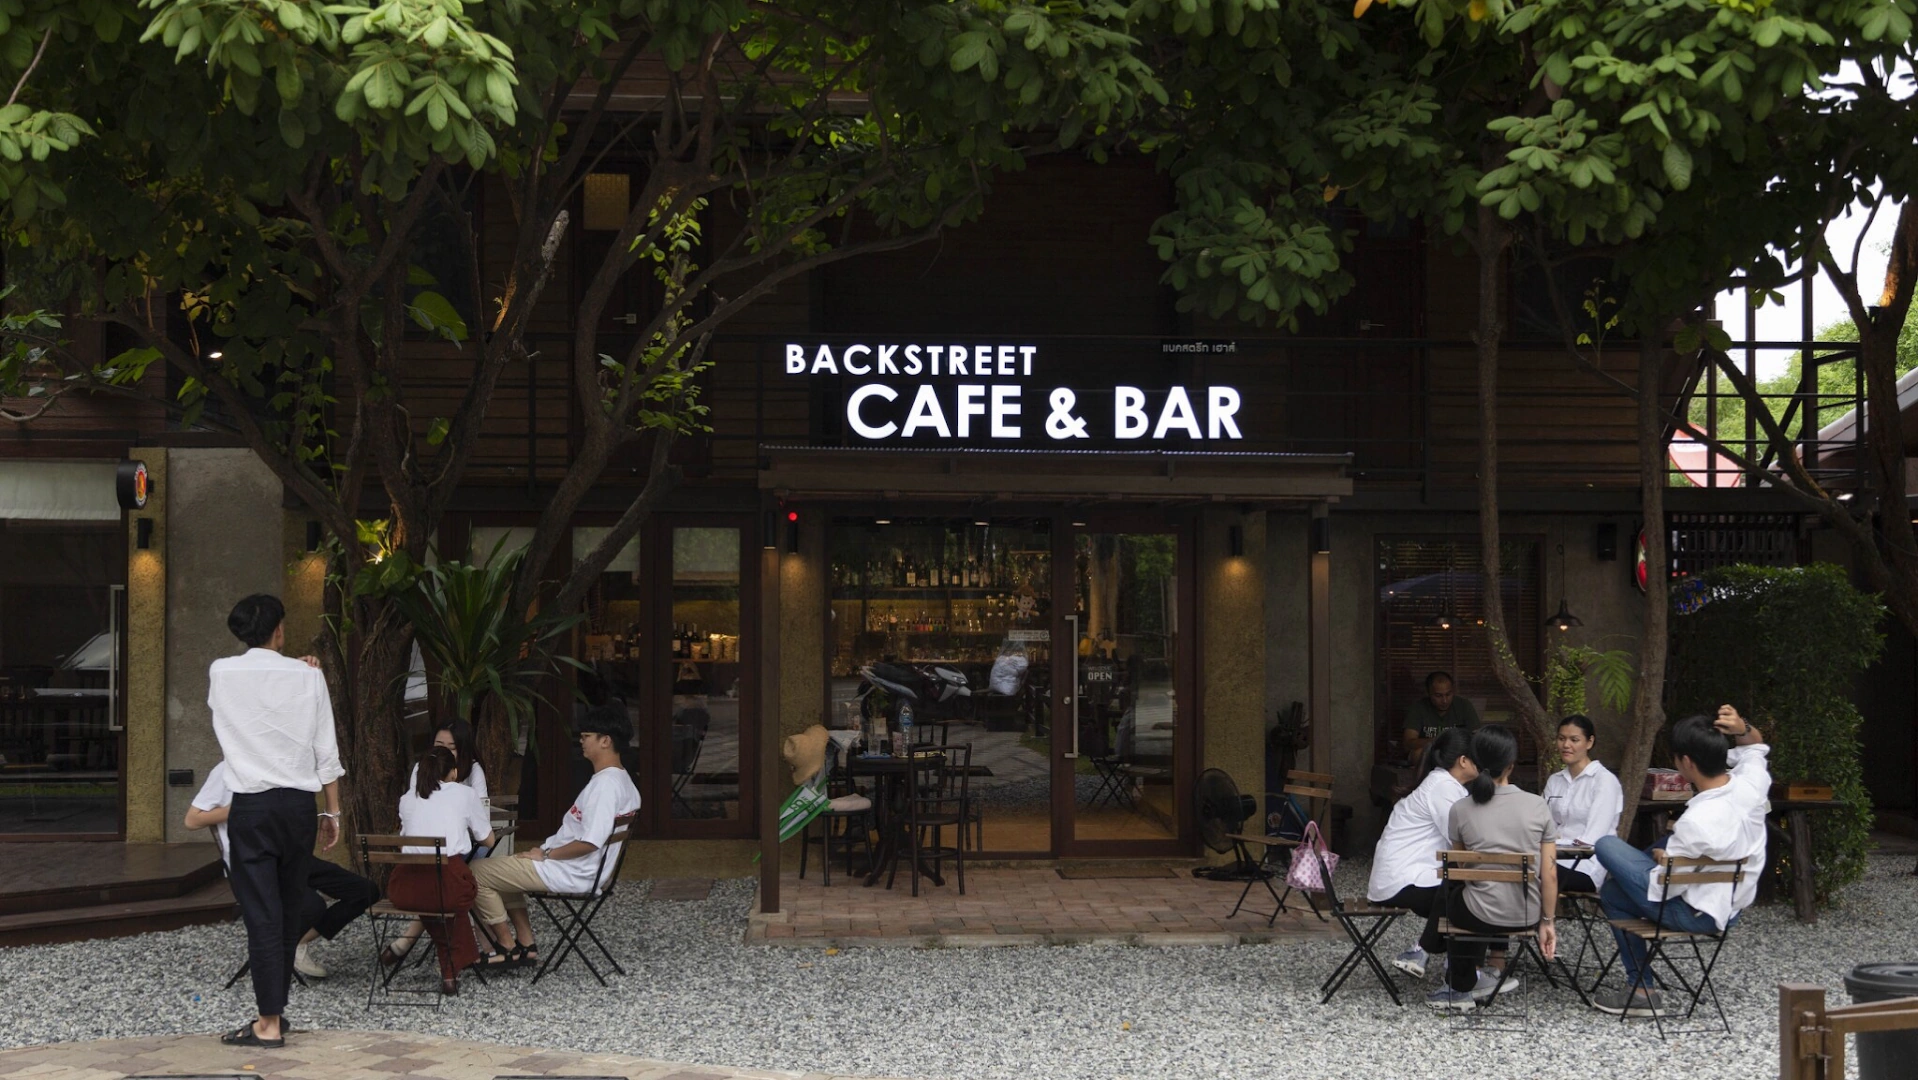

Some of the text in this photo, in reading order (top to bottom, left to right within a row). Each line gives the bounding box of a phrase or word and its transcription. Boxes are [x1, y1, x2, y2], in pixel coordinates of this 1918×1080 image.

[786, 343, 1037, 376] BACKSTREET
[846, 383, 1243, 440] CAFE & BAR
[1088, 672, 1112, 681] OPEN
